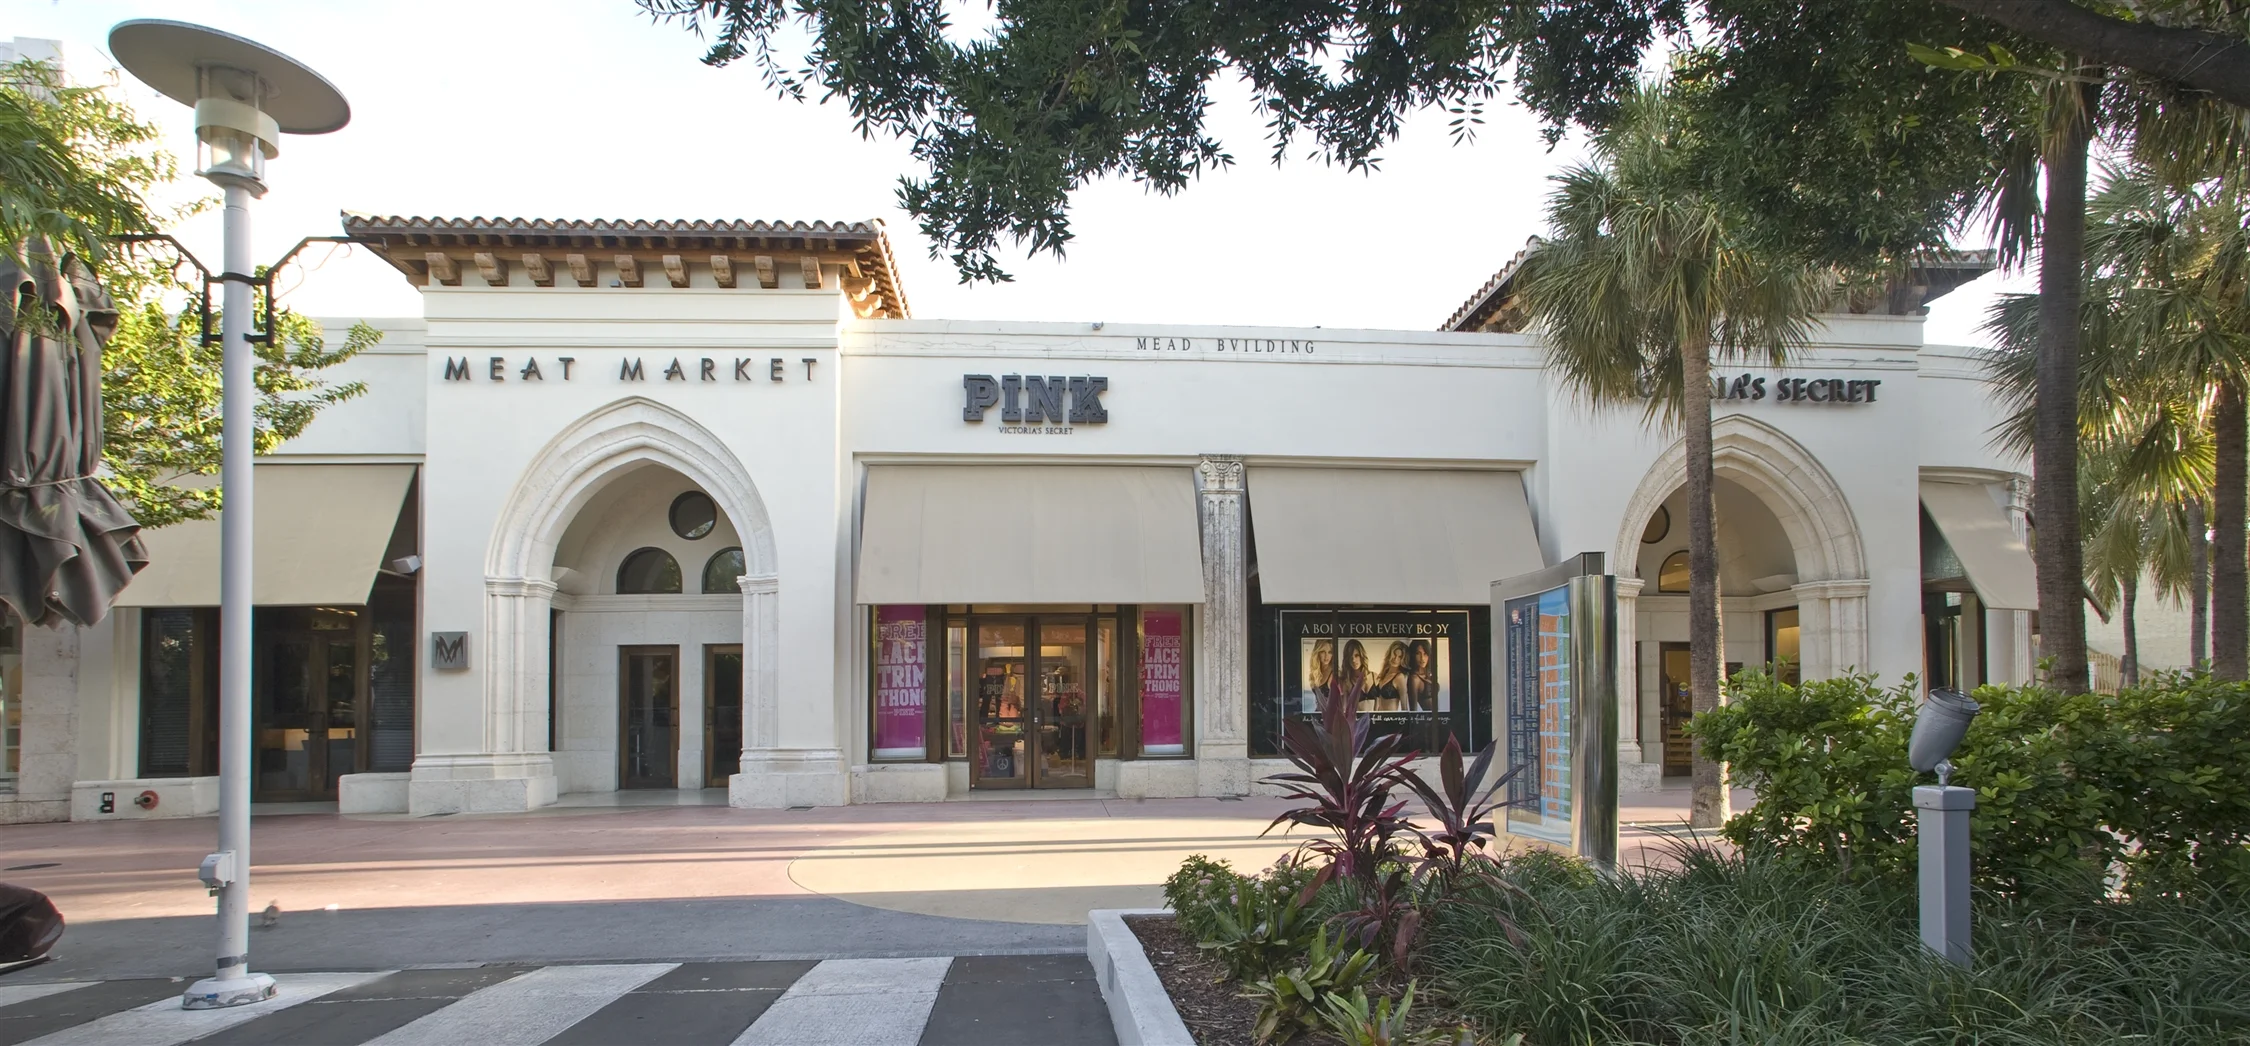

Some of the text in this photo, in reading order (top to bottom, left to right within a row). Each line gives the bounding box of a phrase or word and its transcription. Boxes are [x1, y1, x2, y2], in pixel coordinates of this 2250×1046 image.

[1136, 337, 1191, 351] MEAD
[444, 356, 818, 382] MEAT MARKET
[1777, 377, 1882, 403] SECRET
[963, 374, 1109, 425] PINK
[998, 426, 1074, 435] VICTORIA'S SECRET
[877, 622, 926, 641] FREE
[1301, 623, 1310, 634] A
[1350, 623, 1374, 634] FOR
[1377, 623, 1413, 634] EVERY
[1144, 635, 1180, 648] FREE
[877, 641, 926, 665] LACE
[1144, 648, 1180, 664] LACE
[877, 665, 926, 688] TRIM
[1144, 663, 1180, 680] TRIM
[1144, 680, 1180, 692] THONG
